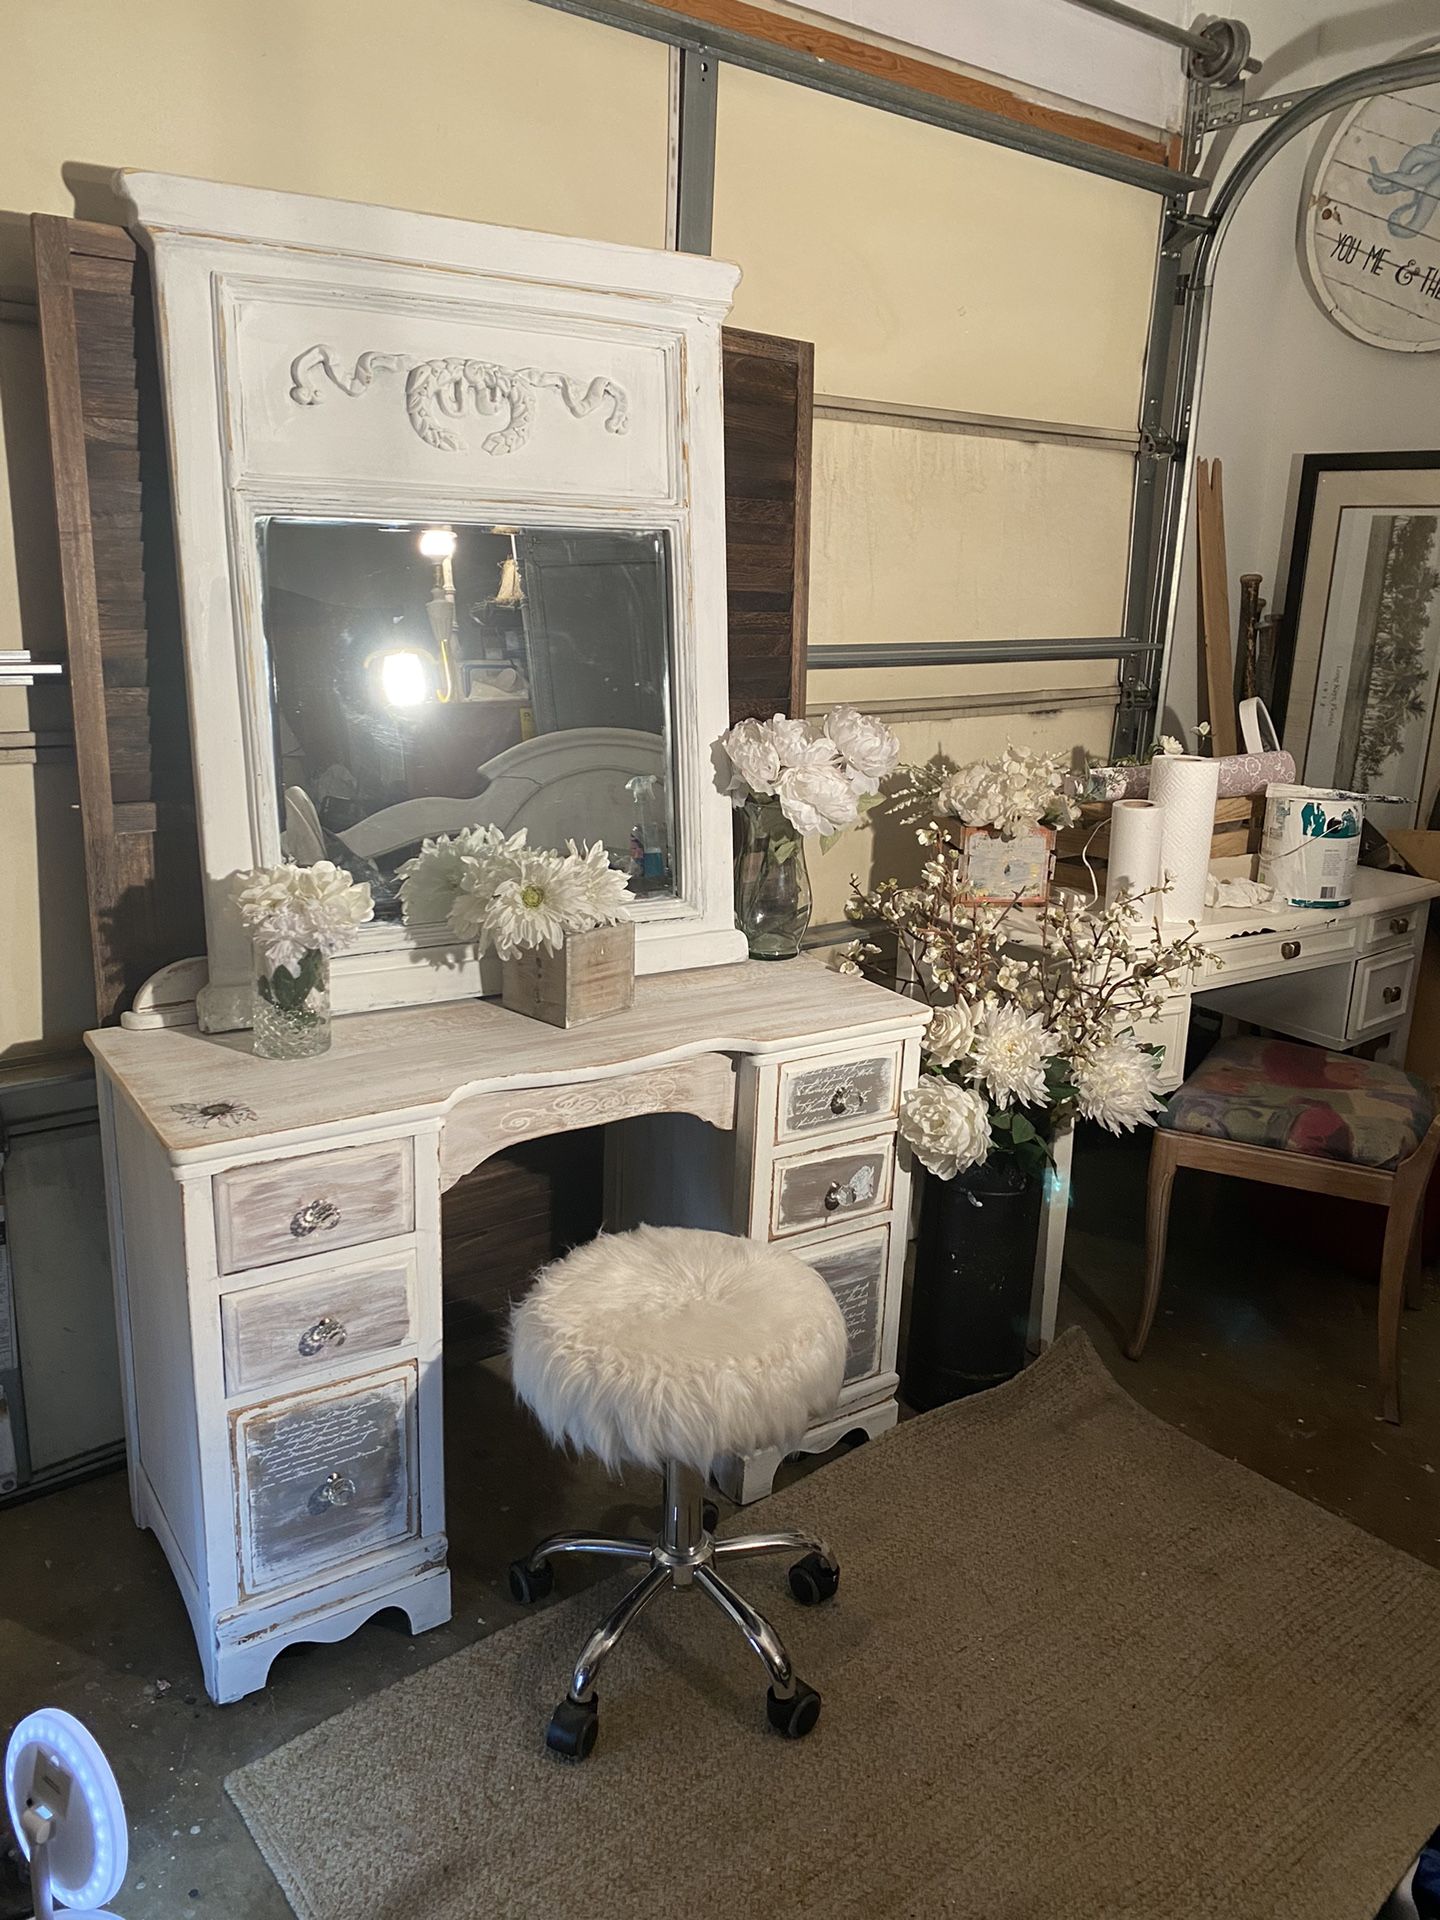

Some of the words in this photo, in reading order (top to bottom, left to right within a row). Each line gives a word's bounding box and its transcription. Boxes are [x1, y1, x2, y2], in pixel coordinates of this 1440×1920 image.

[1330, 232, 1361, 264] YOU
[1362, 245, 1391, 276] ME
[1395, 259, 1420, 285] &
